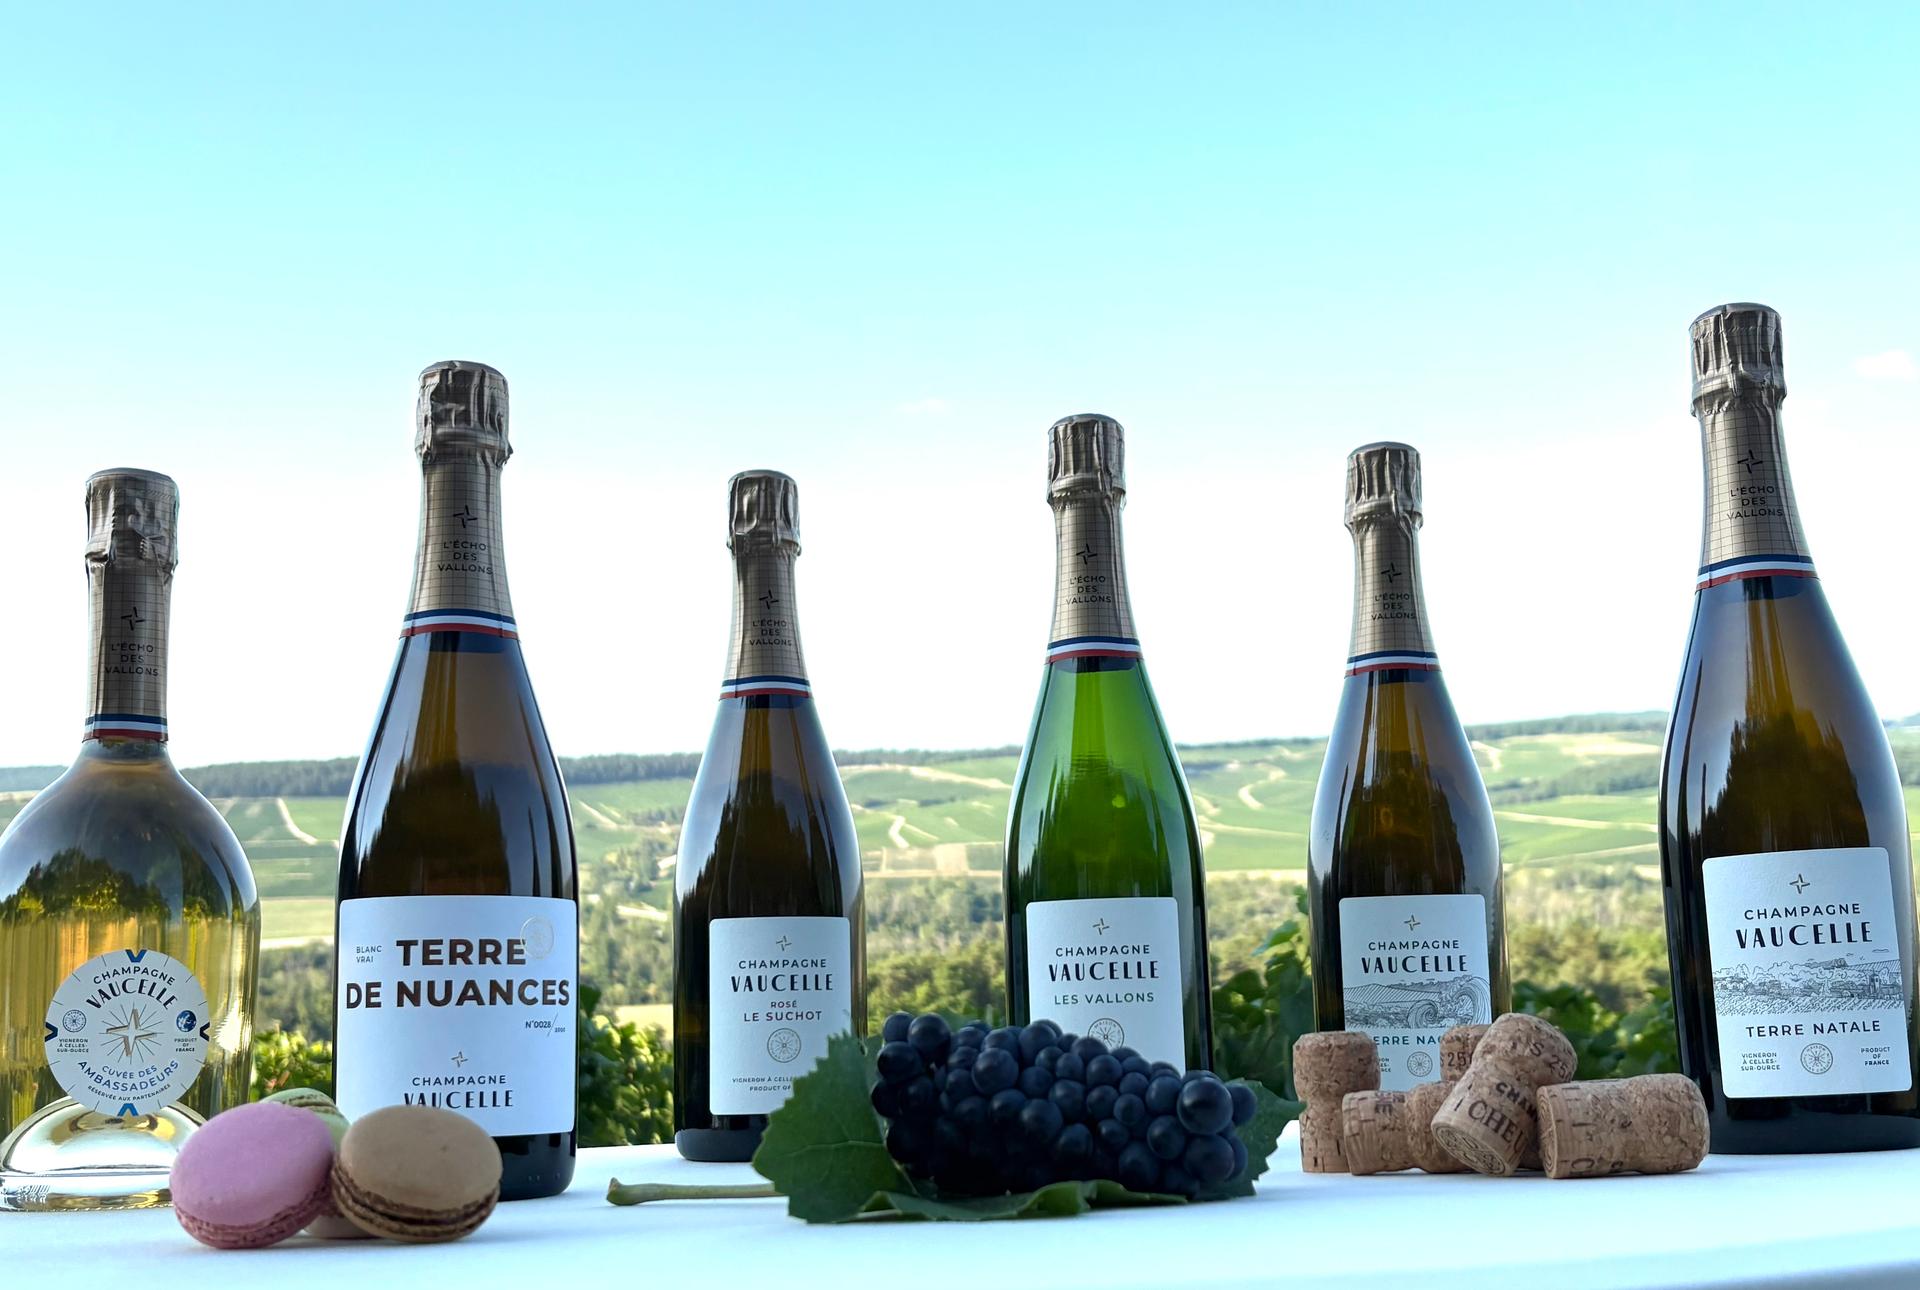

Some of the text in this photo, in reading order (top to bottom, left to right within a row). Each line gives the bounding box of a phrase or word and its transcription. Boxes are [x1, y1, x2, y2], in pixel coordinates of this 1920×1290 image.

[1730, 485, 1775, 497] L'ÉCHO
[1741, 497, 1766, 507] DES
[1726, 508, 1784, 520] VALLONS
[443, 540, 487, 551] L'ÉCHO
[453, 552, 477, 561] DES
[438, 564, 493, 575] VALLONS
[1077, 585, 1097, 593] DES
[1066, 595, 1112, 605] VALLONS
[1383, 602, 1402, 610] DES
[1371, 611, 1416, 621] VALLONS
[761, 628, 780, 636] DES
[749, 638, 793, 647] VALLONS
[120, 654, 145, 663] DES
[104, 666, 159, 677] VALLONS
[1744, 903, 1862, 921] CHAMPAGNE
[1735, 921, 1873, 949] VAUCELLE
[356, 945, 382, 954] BLANC
[1055, 944, 1150, 957] CHAMPAGNE
[1368, 939, 1460, 951] CHAMPAGNE
[396, 938, 527, 967] TERRE
[738, 958, 827, 970] CHAMPAGNE
[1361, 954, 1469, 974] VAUCELLE
[93, 966, 176, 986] CHAMPAGNE
[1048, 960, 1160, 982] VAUCELLE
[731, 973, 833, 993] VAUCELLE
[86, 978, 178, 1010] VAUCELLE
[346, 978, 570, 1009] DE NUANCES
[1054, 992, 1154, 1005] LES VALLONS
[770, 1000, 797, 1009] ROSÉ
[743, 1010, 822, 1022] LE SUCHOT
[1745, 1020, 1882, 1038] TERRE NATALE
[1373, 1035, 1410, 1045] ERRE
[78, 1060, 179, 1092] AMBASSADEURS
[101, 1065, 157, 1079] CUVÉE DES
[412, 1075, 507, 1087] CHAMPAGNE
[404, 1090, 514, 1109] VAUCELLE
